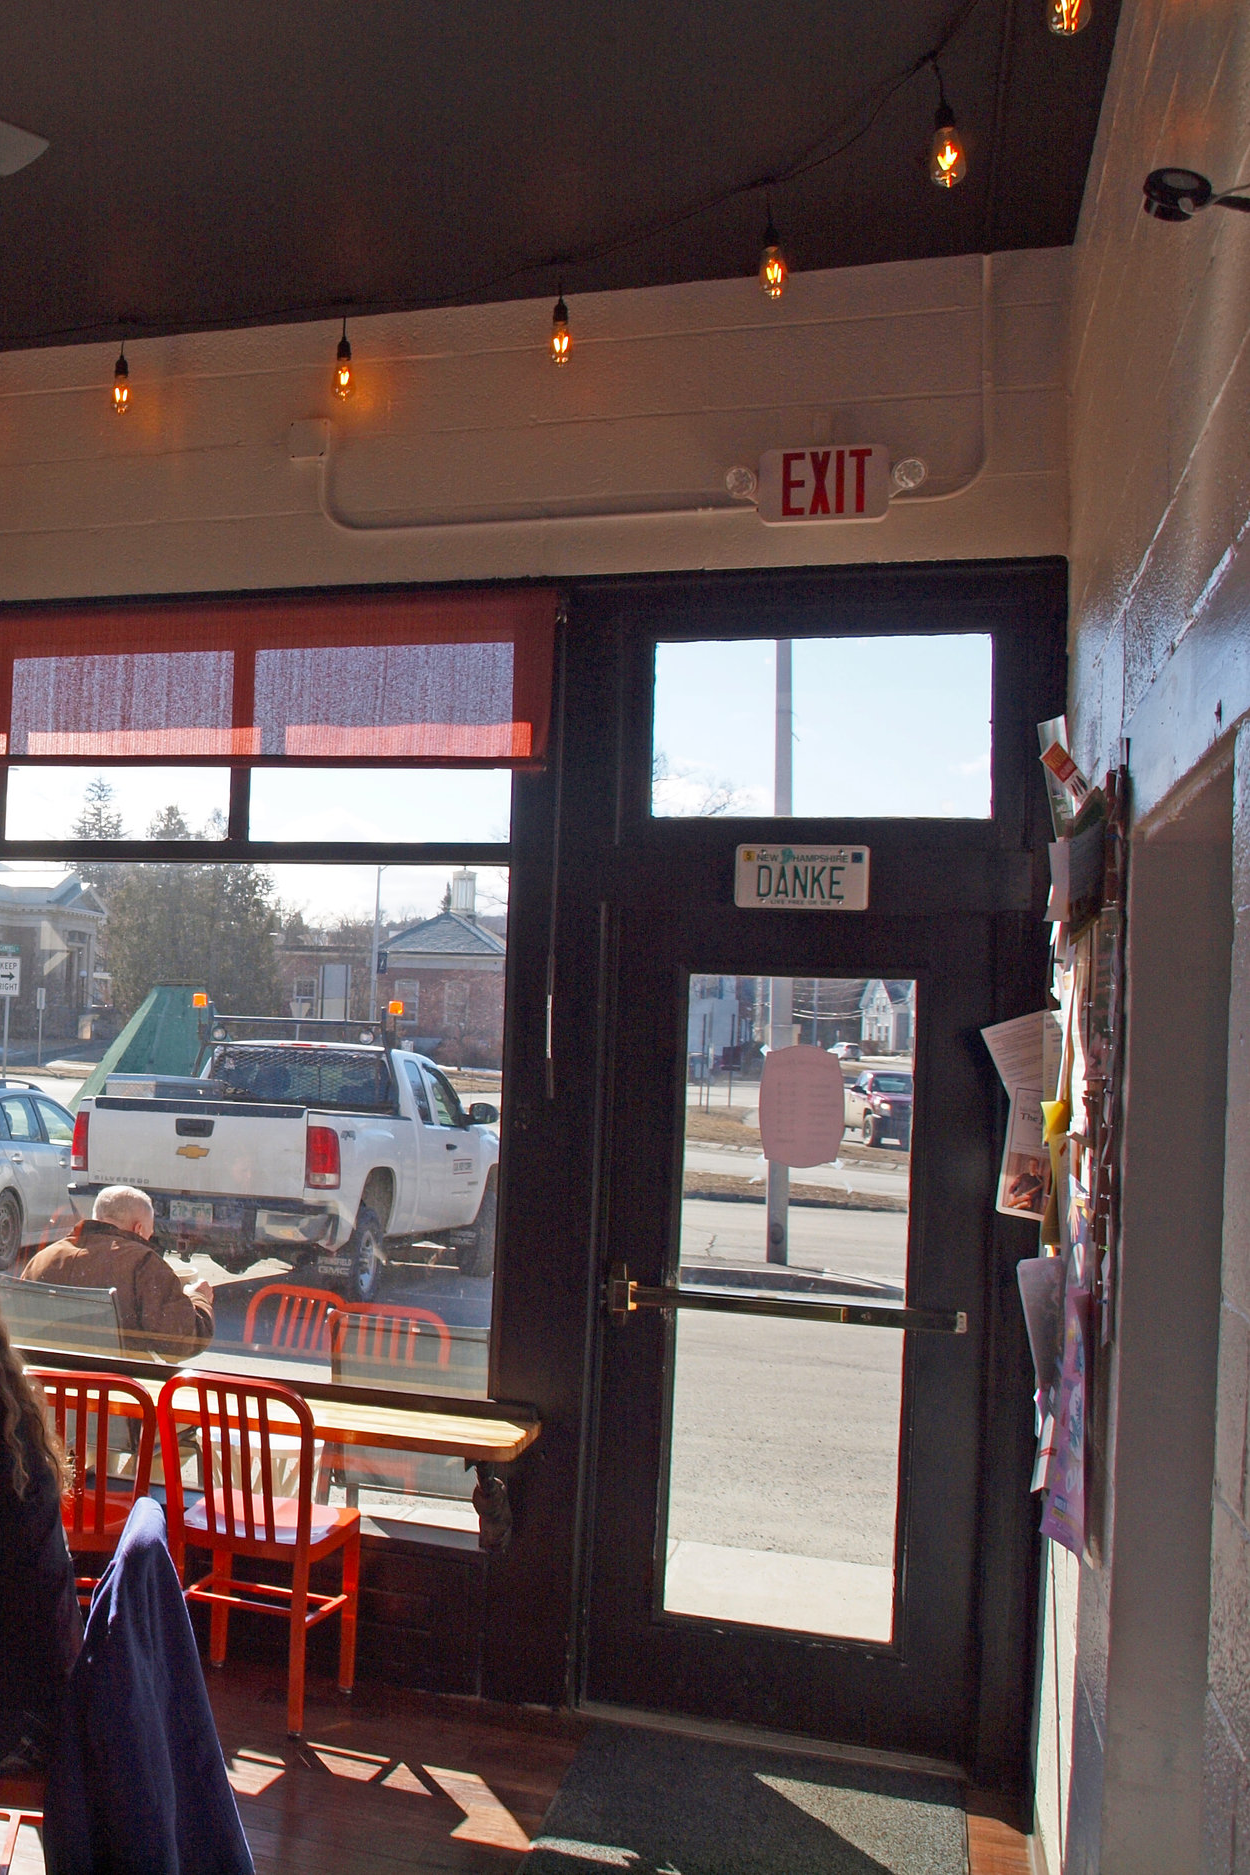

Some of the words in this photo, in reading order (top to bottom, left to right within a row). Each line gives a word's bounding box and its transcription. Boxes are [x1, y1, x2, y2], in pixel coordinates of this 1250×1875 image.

[782, 449, 872, 516] EXIT
[757, 854, 779, 862] NEW
[793, 854, 849, 863] HAMPSHIRE
[757, 865, 845, 899] DANKE
[0, 962, 17, 970] KEEP
[1020, 1112, 1038, 1122] The
[94, 1175, 150, 1184] SILVERADO
[318, 1266, 351, 1276] GMC
